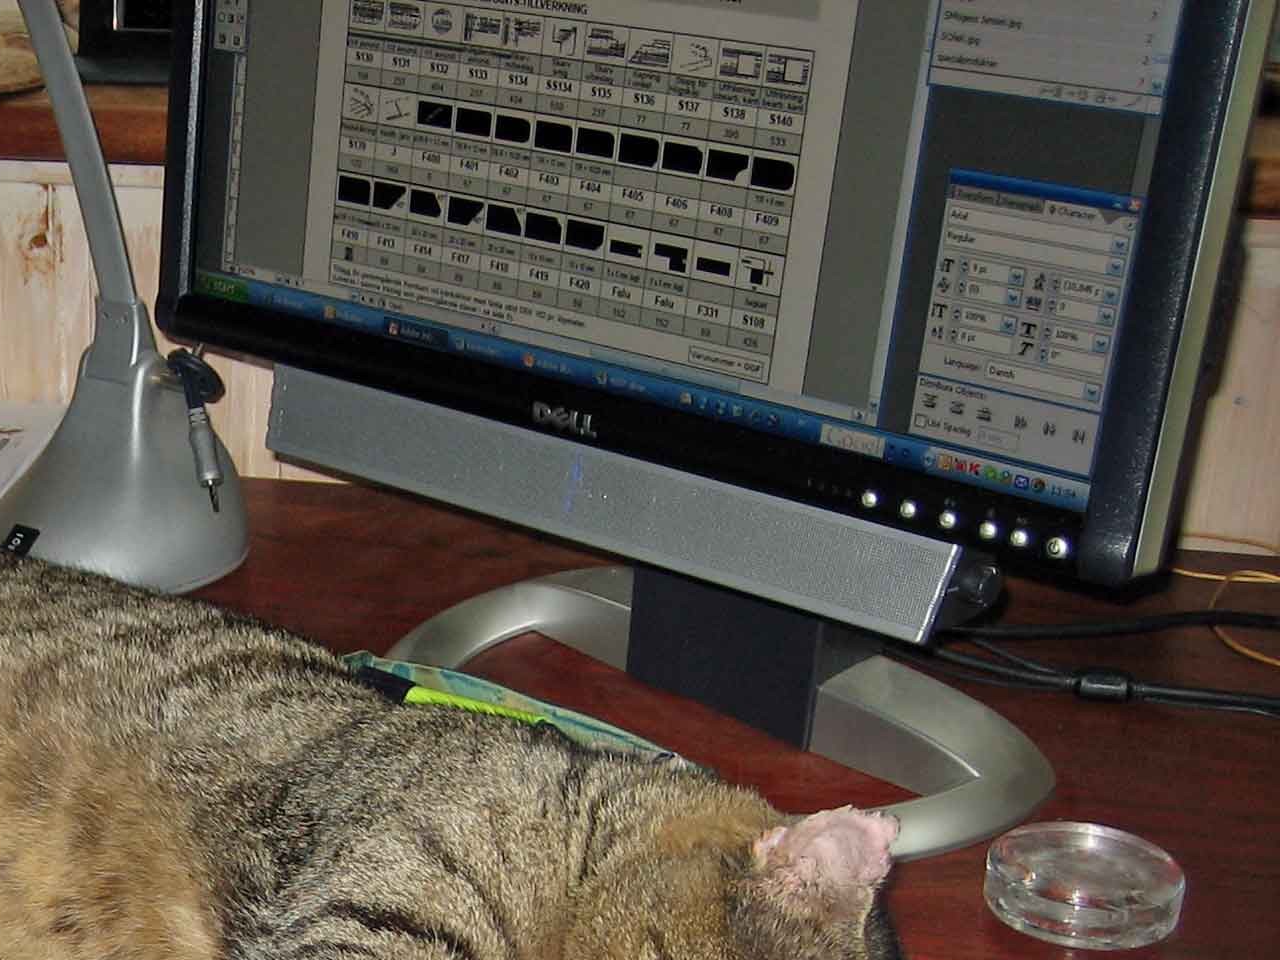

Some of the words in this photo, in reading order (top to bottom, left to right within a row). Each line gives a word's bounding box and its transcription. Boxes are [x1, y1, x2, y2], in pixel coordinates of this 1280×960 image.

[430, 62, 449, 75] S132
[469, 68, 488, 81] S133
[508, 74, 528, 87] S134
[591, 86, 612, 98] S135
[633, 92, 655, 105] S136
[677, 99, 700, 113] S137
[723, 106, 746, 120] S138
[770, 113, 792, 127] S140
[499, 167, 519, 178] F402
[539, 174, 559, 186] F403
[580, 181, 601, 194] F404
[622, 189, 644, 201] F405
[666, 197, 688, 210] F406
[710, 205, 733, 218] F408
[755, 213, 779, 226] F409
[697, 304, 719, 318] F331
[532, 401, 597, 439] DELL
